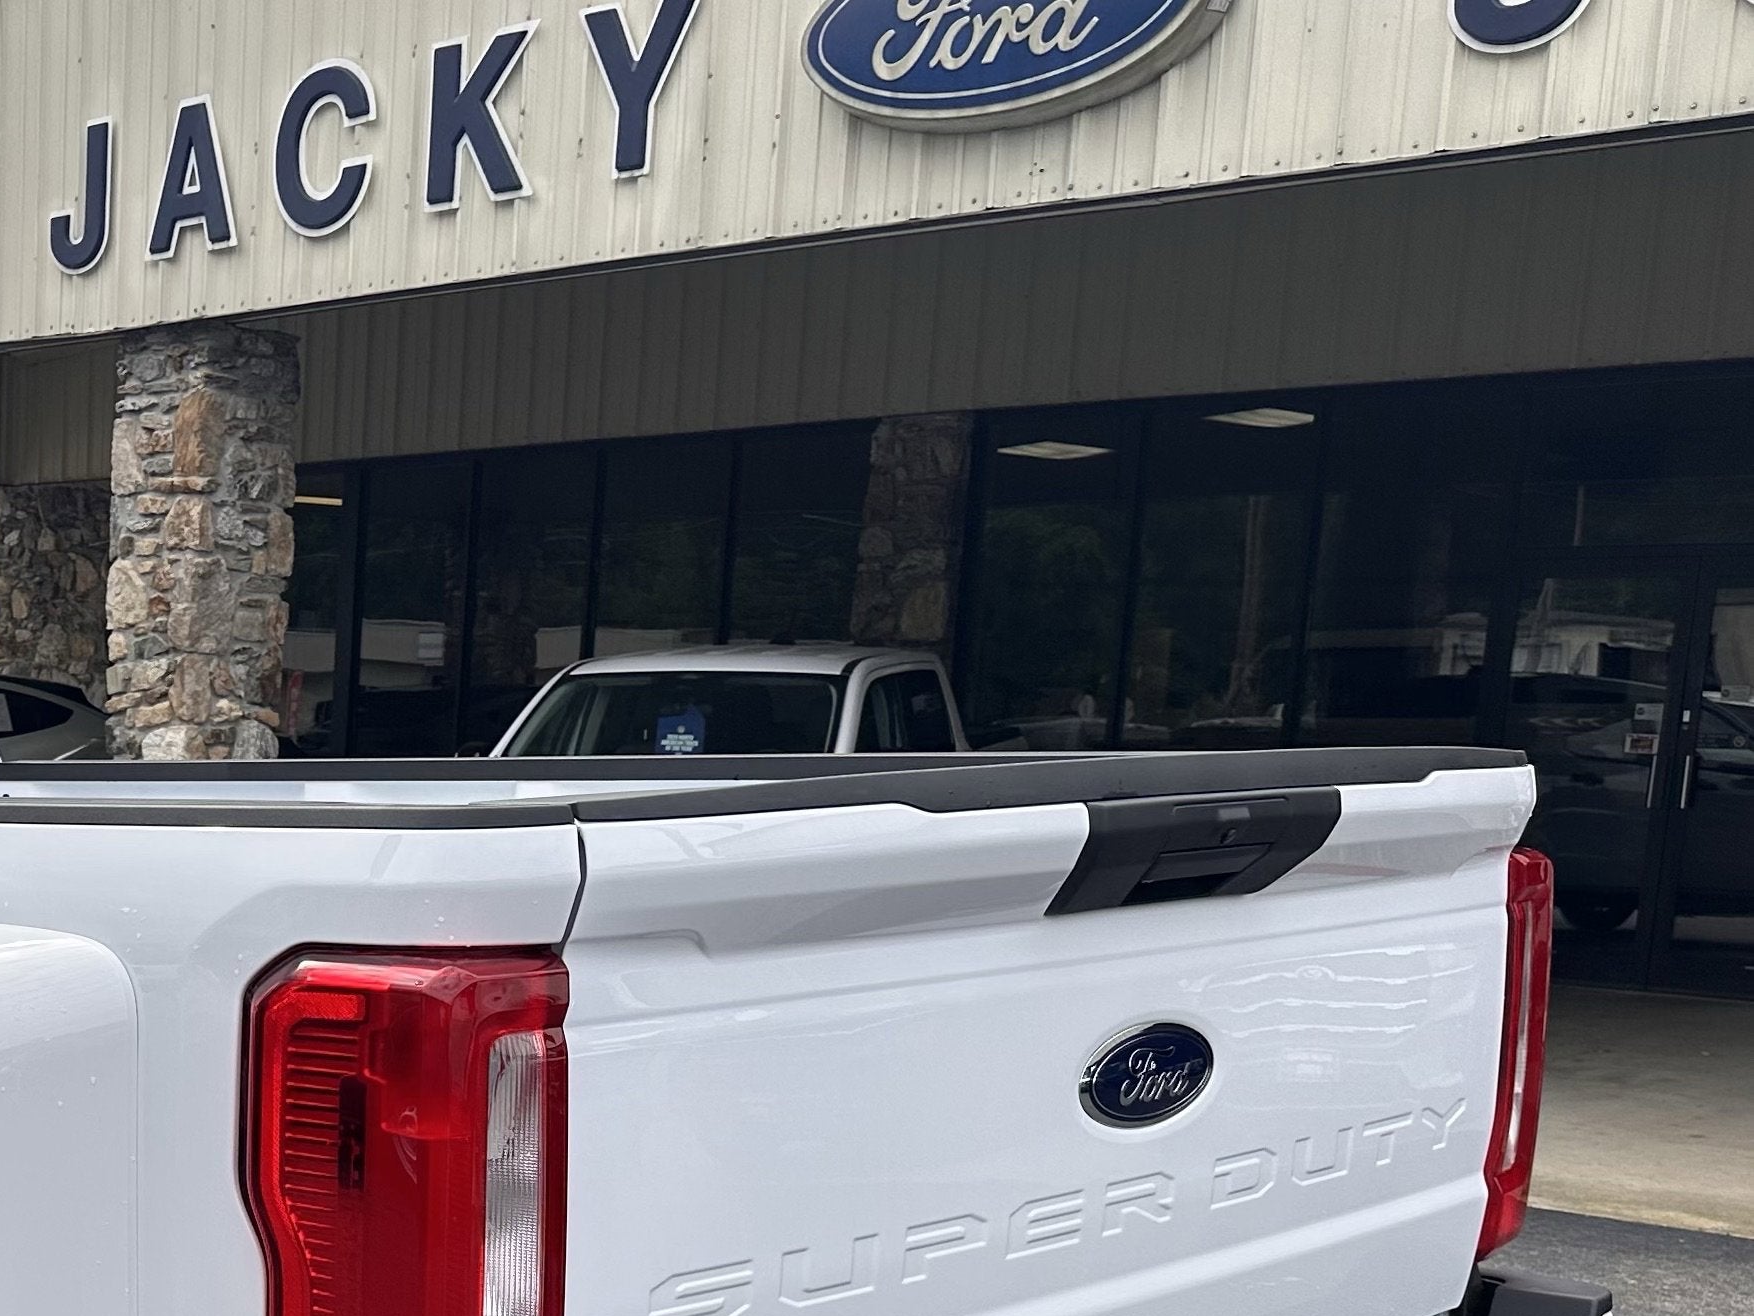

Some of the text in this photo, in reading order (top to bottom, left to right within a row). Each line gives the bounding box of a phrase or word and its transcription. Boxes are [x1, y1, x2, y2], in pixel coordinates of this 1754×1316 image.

[49, 0, 700, 276] JACKY
[1119, 1045, 1191, 1107] Ford
[1209, 1096, 1468, 1211] DUTY
